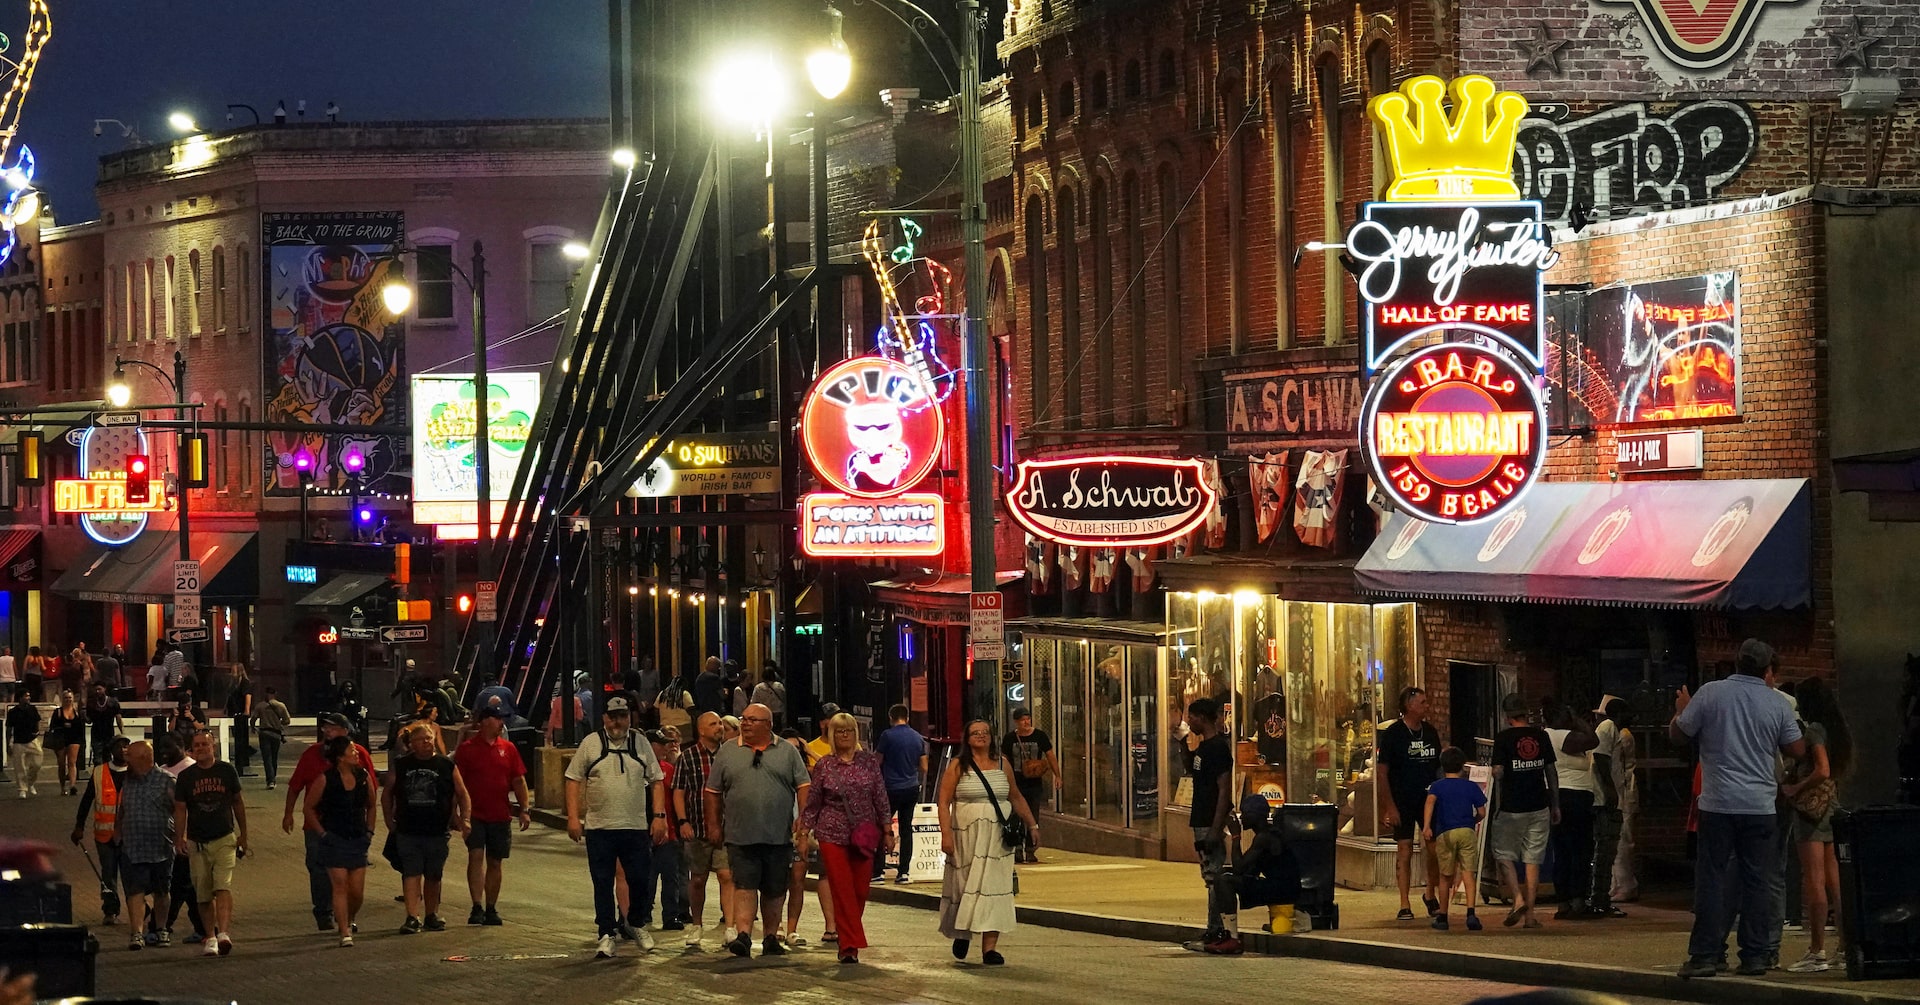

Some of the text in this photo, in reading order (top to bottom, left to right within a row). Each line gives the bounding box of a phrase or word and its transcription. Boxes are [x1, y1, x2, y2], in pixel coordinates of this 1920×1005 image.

[1437, 178, 1474, 194] KING
[276, 225, 393, 238] BACK TO THE GRIND
[1347, 220, 1457, 303] Jerry
[1382, 305, 1531, 323] HALL OF FAME
[1414, 352, 1496, 386] BAR
[1377, 411, 1534, 456] RESTAURANT
[681, 472, 773, 482] WORLD FAMOUS
[700, 481, 753, 491] IRISH BAR
[1063, 467, 1202, 510] Schwab
[1390, 462, 1527, 516] 159 BEALE
[812, 504, 935, 522] PORK WITH
[1053, 519, 1168, 534] ESTABLISHED 1876
[812, 526, 840, 544] AN
[176, 578, 198, 590] 20
[480, 583, 493, 591] NO
[977, 595, 996, 607] NO
[1411, 741, 1424, 749] JUST
[1421, 748, 1430, 757] DO
[1512, 759, 1545, 769] Element
[194, 777, 222, 787] HARLEY
[192, 785, 226, 796] DAVIDSON
[920, 836, 939, 845] WE
[919, 848, 942, 858] ARE
[916, 861, 940, 870] OPE
